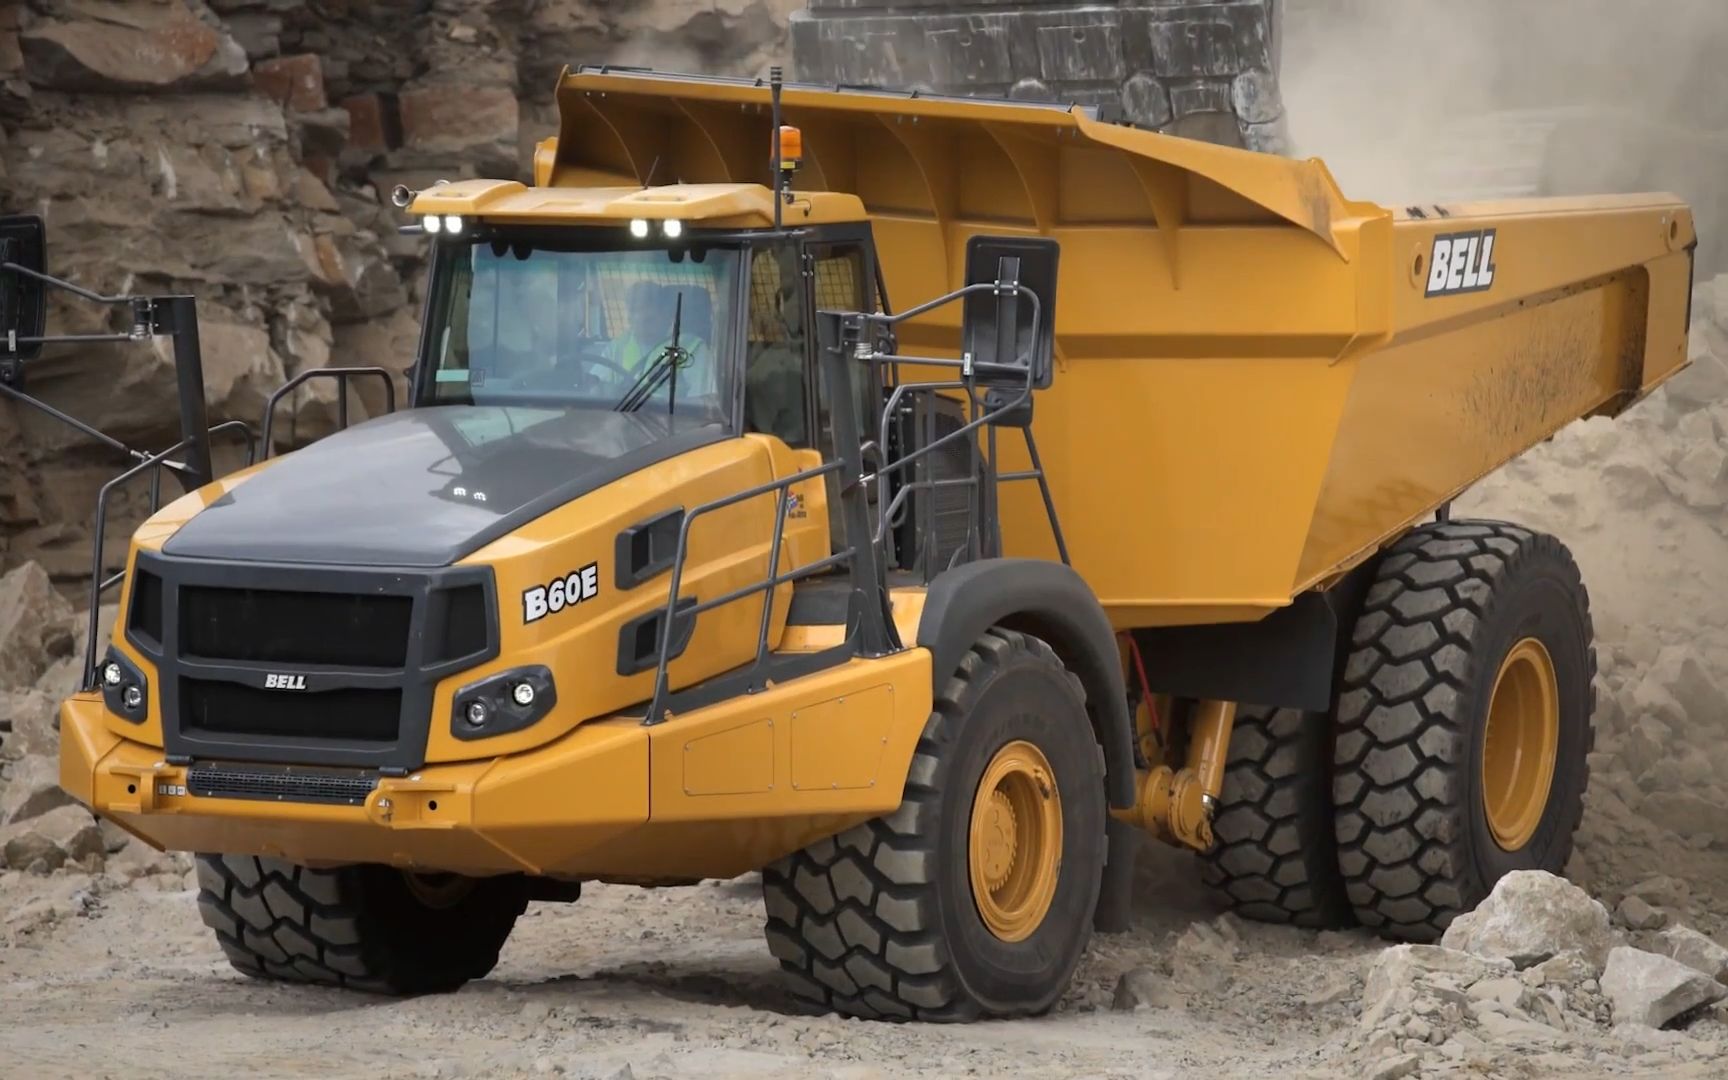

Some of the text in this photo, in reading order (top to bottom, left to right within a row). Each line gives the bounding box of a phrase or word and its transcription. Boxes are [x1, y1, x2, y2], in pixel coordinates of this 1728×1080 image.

[1426, 233, 1494, 293] BELL
[523, 563, 598, 623] B60E
[264, 673, 306, 690] BELL
